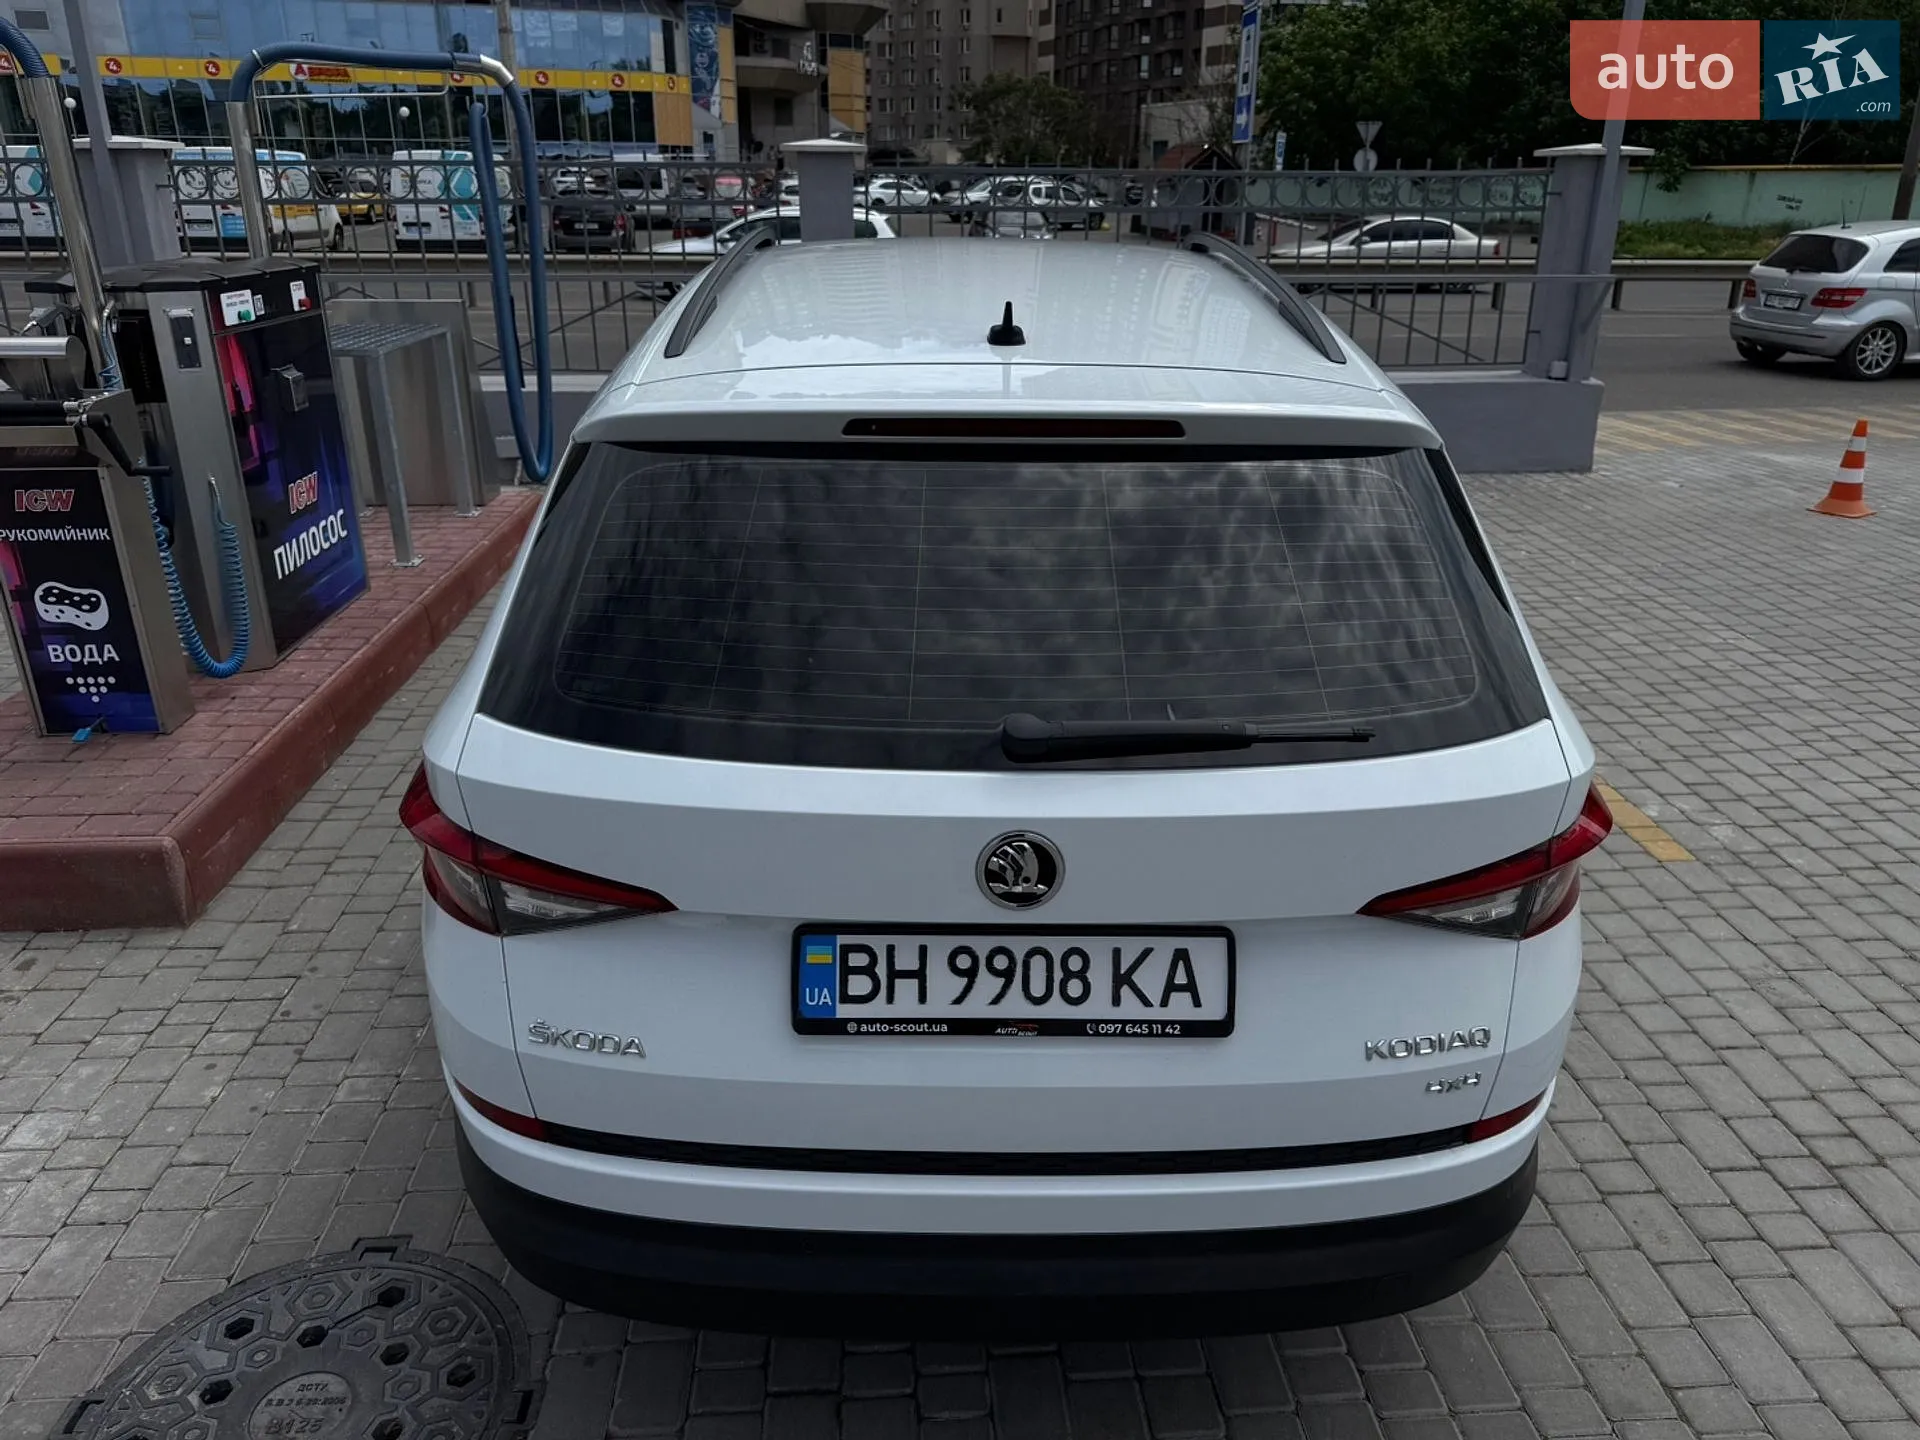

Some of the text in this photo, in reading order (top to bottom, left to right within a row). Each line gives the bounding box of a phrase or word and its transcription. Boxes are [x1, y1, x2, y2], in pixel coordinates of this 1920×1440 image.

[14, 490, 74, 511] ICW
[288, 471, 318, 514] ICW
[273, 508, 347, 580] ПИЛОСОС
[48, 644, 120, 665] ВОДА
[839, 943, 1202, 1008] BH 9908 KA
[805, 988, 832, 1006] UA
[859, 1022, 948, 1032] auto-scout.ua
[1098, 1023, 1181, 1035] 097 645 11 42
[1365, 1026, 1491, 1061] KODIAQ
